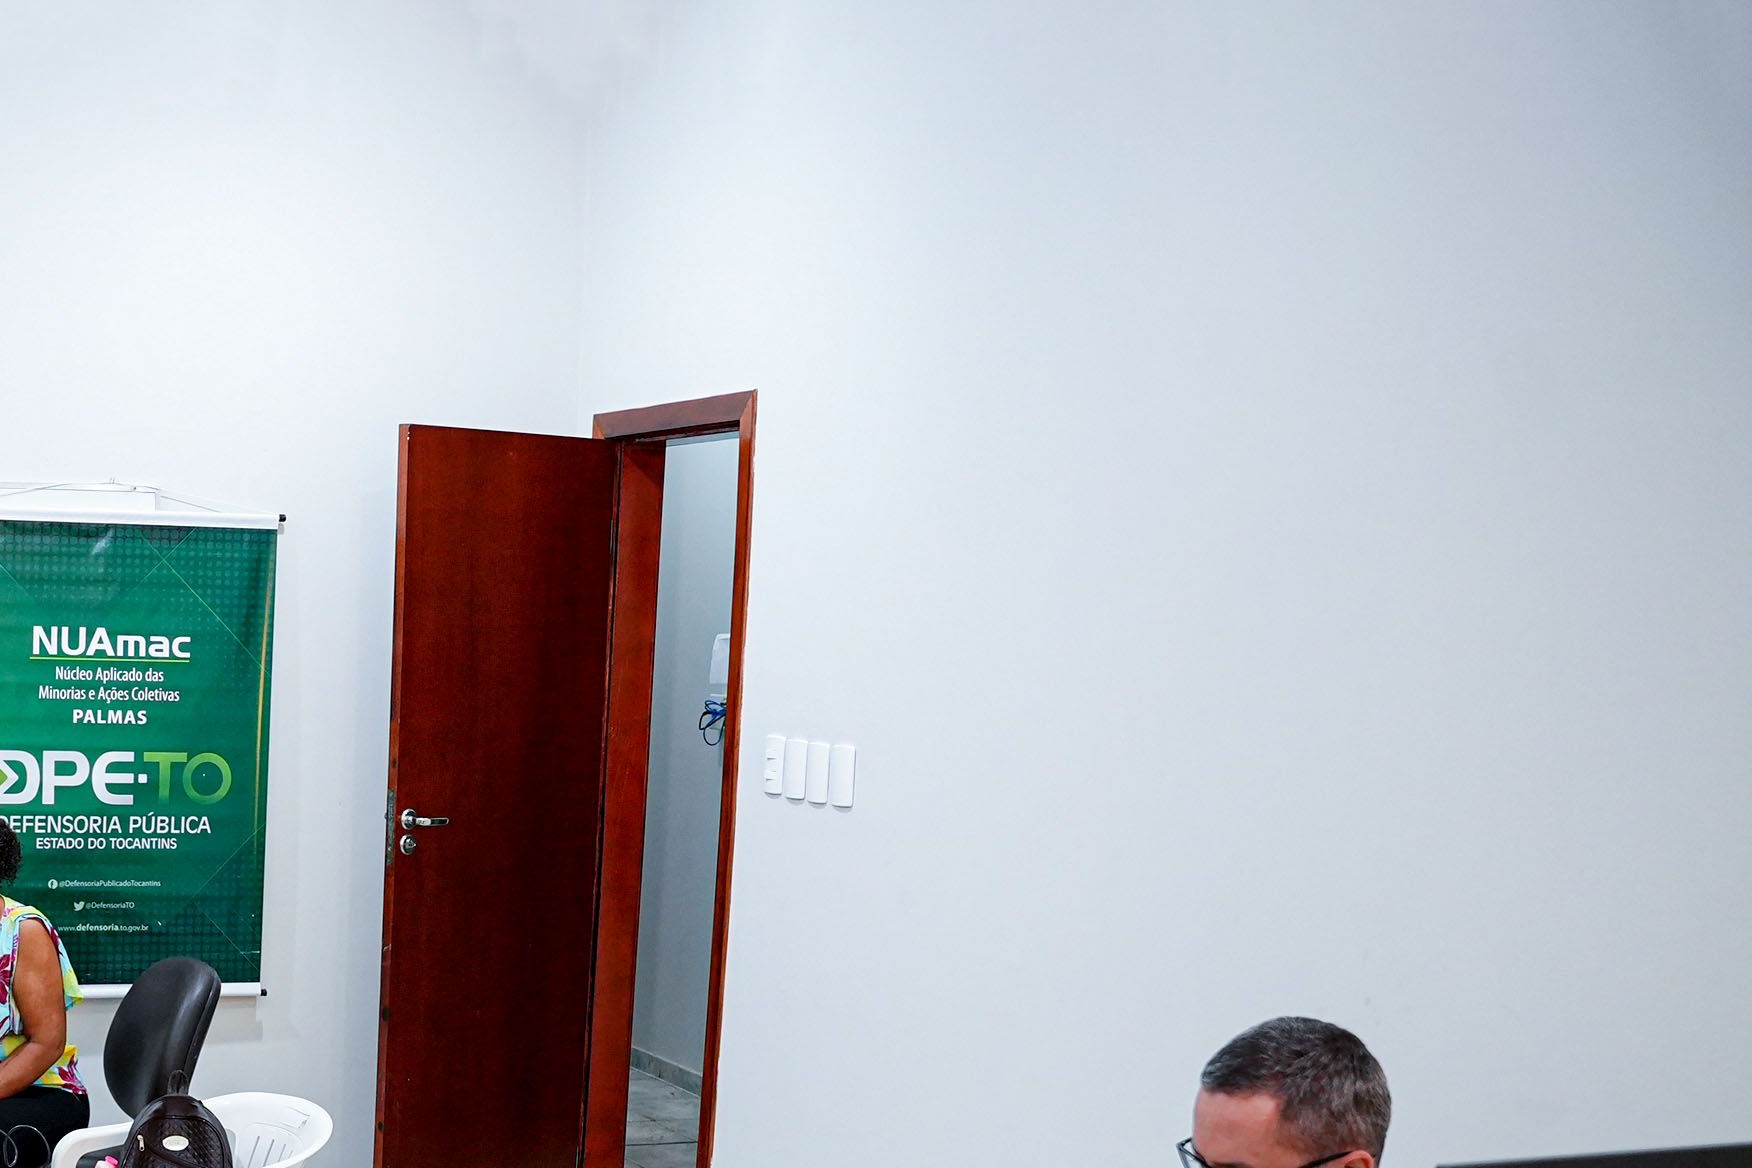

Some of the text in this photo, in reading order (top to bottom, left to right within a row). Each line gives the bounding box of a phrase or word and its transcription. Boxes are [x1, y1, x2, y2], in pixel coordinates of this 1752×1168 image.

[32, 625, 191, 658] NUAmac
[55, 666, 164, 684] Núcleo Aplicado das
[38, 685, 180, 704] Minorias e Ações Coletivas
[72, 709, 147, 725] PALMAS
[129, 811, 211, 834] PÚBLICA
[35, 837, 178, 850] ESTADO DO TOCANTINS
[59, 879, 161, 888] @DefensoriaPublicadoTocantins
[86, 901, 135, 910] @DefensoriaTO
[58, 923, 149, 932] www.defensoria.to.gov.br
